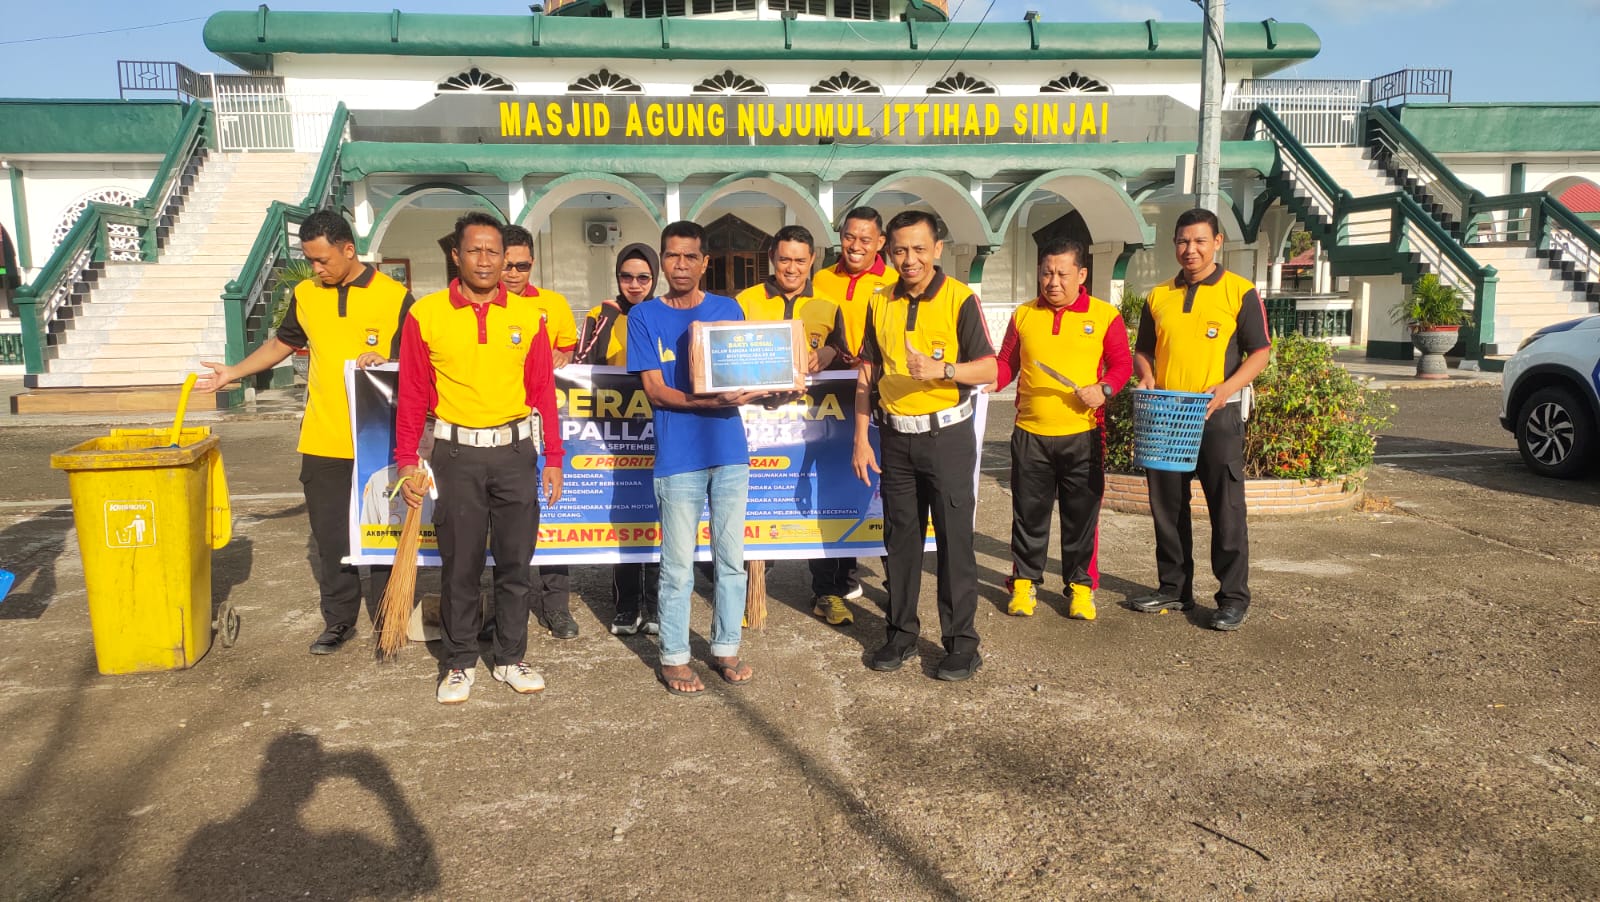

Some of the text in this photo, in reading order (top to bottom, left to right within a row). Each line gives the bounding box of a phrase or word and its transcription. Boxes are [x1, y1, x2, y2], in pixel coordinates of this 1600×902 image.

[500, 102, 1108, 137] MASJID AGUNG NUJUMUL ITTIHAD SINJAI
[584, 458, 593, 468] 7
